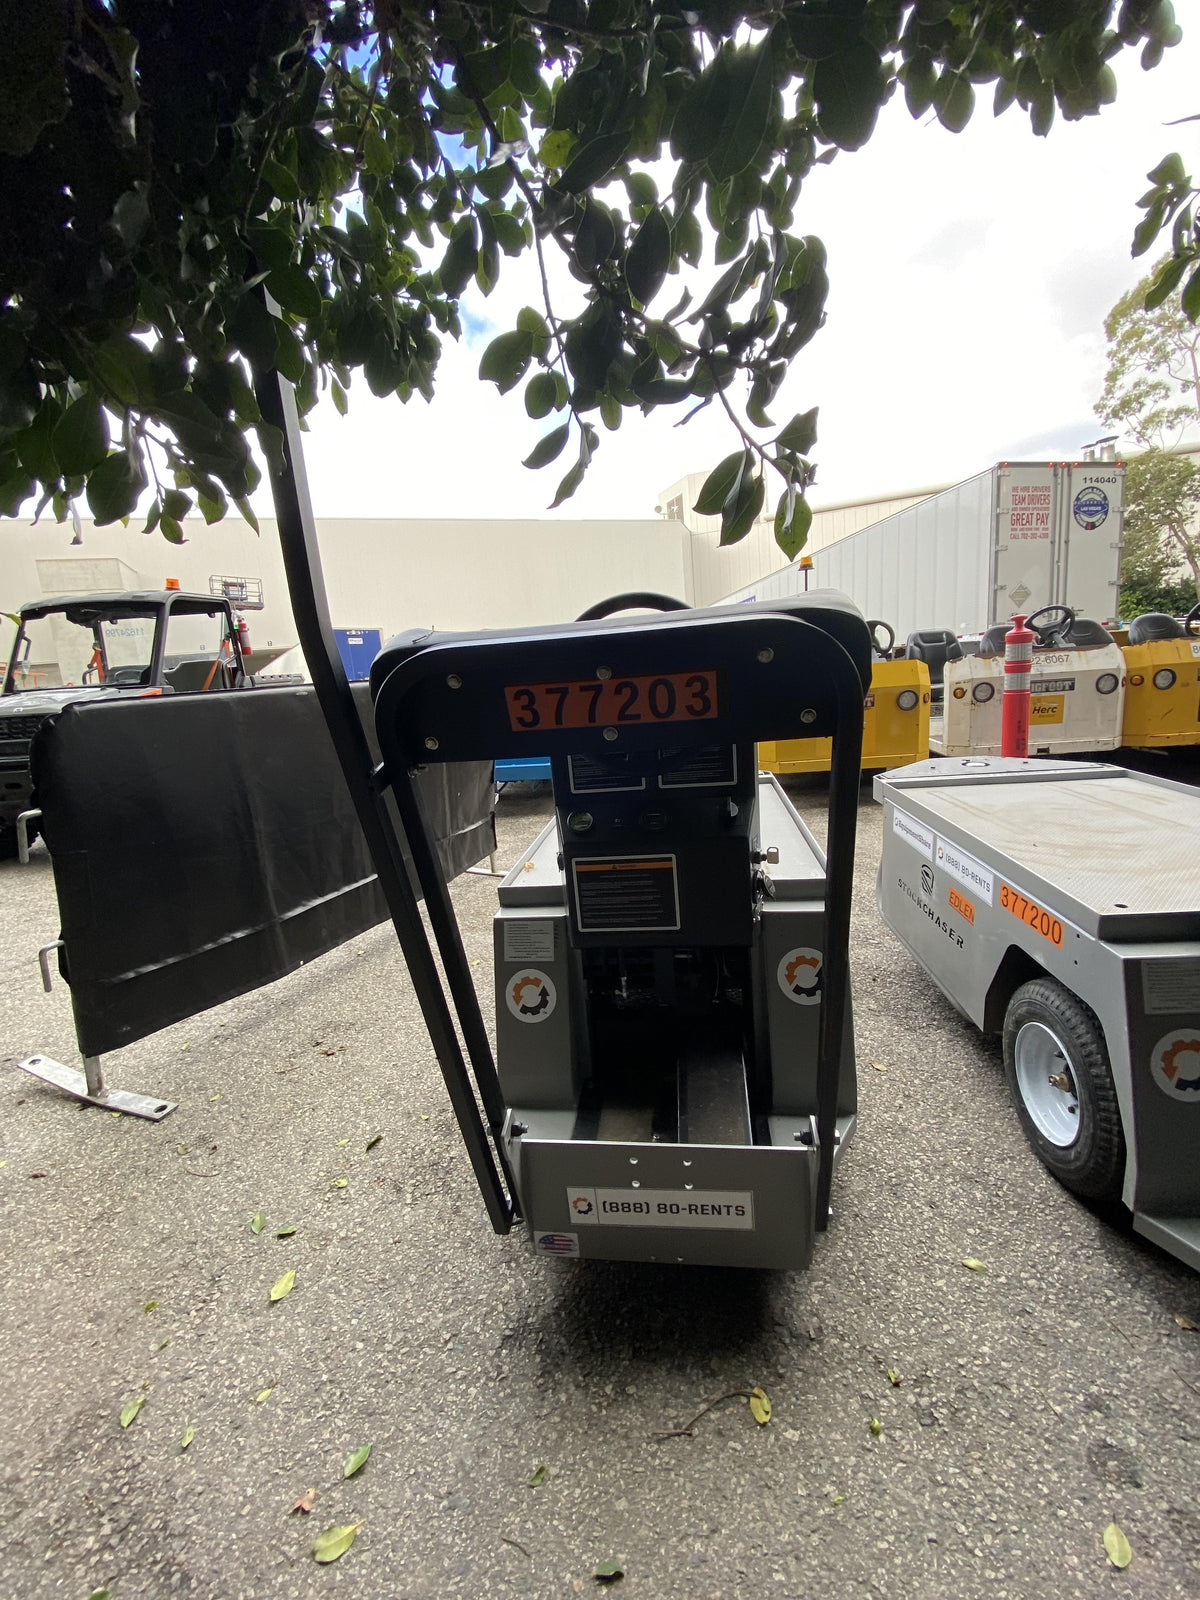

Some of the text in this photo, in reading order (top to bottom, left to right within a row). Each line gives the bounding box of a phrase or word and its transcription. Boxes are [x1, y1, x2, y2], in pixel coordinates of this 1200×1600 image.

[1012, 494, 1050, 505] TEAM DRIVERS
[1011, 512, 1050, 526] GREAT PAY
[1031, 680, 1073, 693] IGFOOT
[512, 675, 712, 729] 377203
[1032, 706, 1057, 714] Herc
[945, 853, 991, 893] (888) 80-RENTS
[897, 878, 964, 949] STOCKCHASER
[949, 892, 976, 923] EDLEN
[1001, 886, 1063, 945] 377200
[603, 1200, 746, 1217] (888) 80-RENTS
